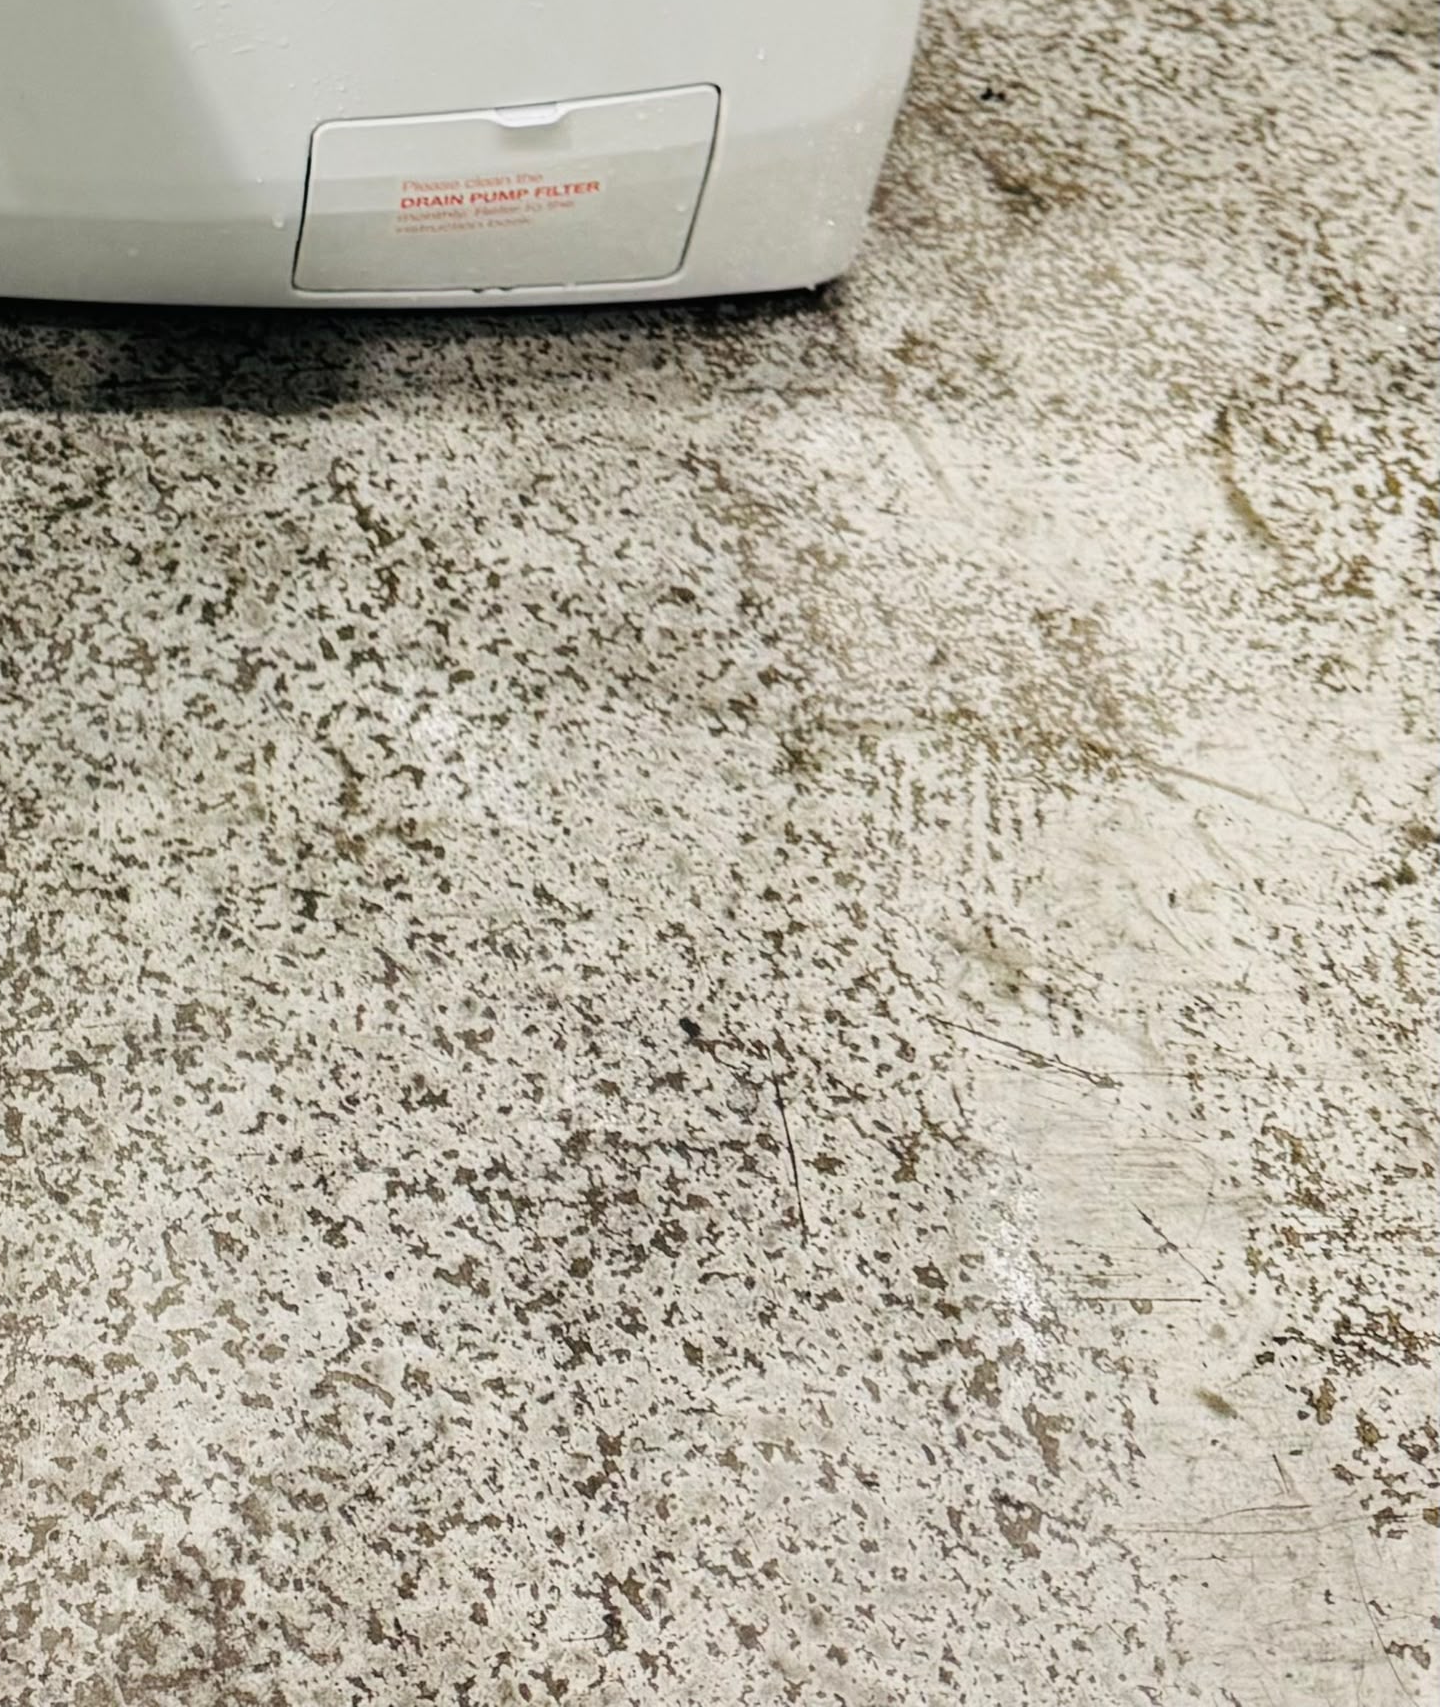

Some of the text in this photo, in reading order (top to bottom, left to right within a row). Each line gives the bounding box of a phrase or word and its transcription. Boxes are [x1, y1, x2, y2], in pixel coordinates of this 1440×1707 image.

[516, 173, 543, 183] the
[400, 181, 600, 209] DRAIN PUMP FILTER
